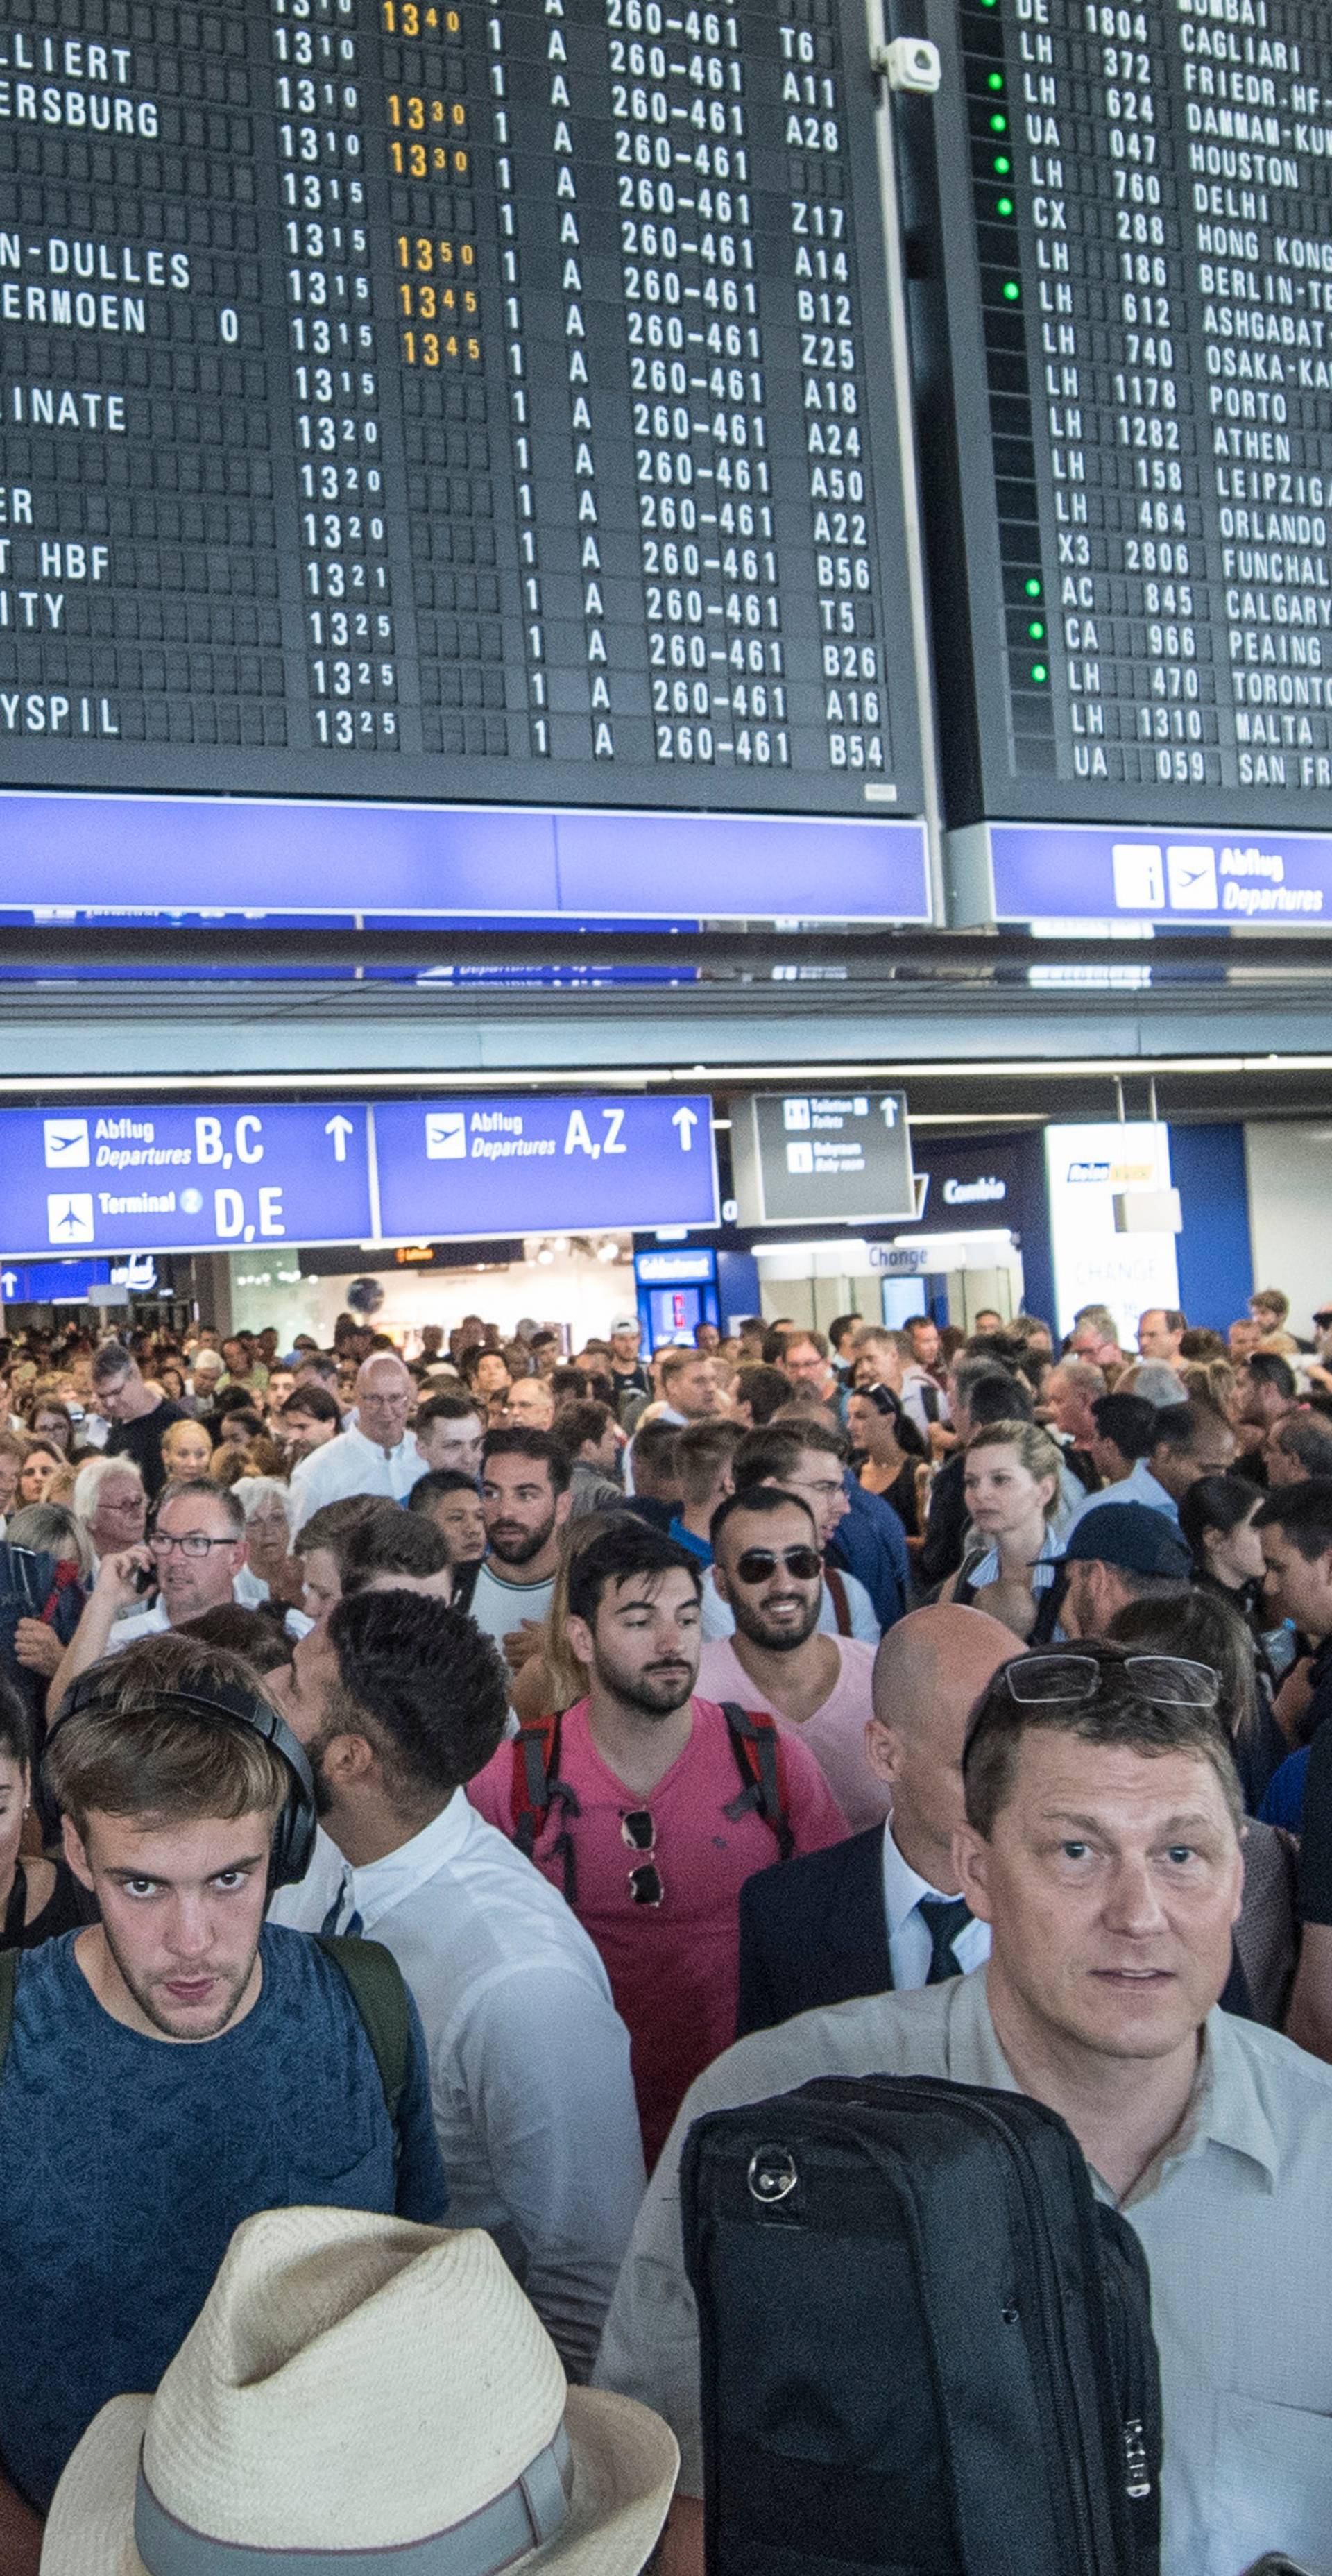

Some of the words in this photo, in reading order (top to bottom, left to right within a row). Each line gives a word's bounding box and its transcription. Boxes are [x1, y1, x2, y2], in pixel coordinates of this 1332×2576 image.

[607, 0, 737, 46] 260-461
[780, 27, 813, 62] T6
[1017, 0, 1048, 22] DE
[1087, 5, 1147, 41] 1804
[1181, 23, 1299, 72] CAGLIARI
[1021, 31, 1052, 63] LH
[1104, 47, 1150, 83] 372
[549, 30, 566, 60] A
[610, 40, 740, 91] 260-461
[783, 71, 832, 108] A11
[0, 33, 130, 83] LIERT
[554, 121, 572, 152] A
[616, 130, 746, 180] 260-461
[613, 85, 742, 135] 260-461
[787, 115, 837, 151] A28
[1025, 73, 1055, 105] LH
[1107, 88, 1153, 122] 624
[1027, 114, 1059, 146] UA
[1111, 129, 1155, 162] 047
[1190, 143, 1298, 187] HOUSTON
[619, 176, 749, 223] 260-461
[792, 202, 843, 237] Z17
[1032, 156, 1062, 187] LH
[1114, 170, 1160, 204] 760
[1194, 183, 1267, 221] DELHI
[561, 212, 579, 244] A
[622, 221, 752, 268] 260-461
[796, 246, 848, 281] A14
[1034, 197, 1066, 229] CX
[1118, 211, 1163, 244] 288
[1198, 223, 1258, 260] HONG
[1276, 237, 1332, 272] KONG
[1038, 239, 1068, 271] LH
[1123, 253, 1166, 286] 186
[0, 232, 189, 288] N-DULLES
[567, 305, 584, 336] A
[628, 312, 758, 357] 260-461
[802, 334, 854, 369] Z25
[624, 266, 755, 312] 260-461
[799, 290, 851, 325] B12
[1040, 281, 1072, 312] LH
[1124, 293, 1170, 327] 612
[3, 283, 144, 332] ERMOEN
[631, 357, 760, 402] 260-461
[805, 378, 856, 413] A18
[1043, 323, 1075, 354] LH
[1127, 334, 1172, 368] 740
[1206, 345, 1332, 388] OSAKA-KA
[1047, 365, 1078, 396] LH
[1116, 374, 1176, 409] 1178
[1210, 385, 1286, 423] PORTO
[14, 387, 125, 430] INATE
[637, 449, 768, 491] 260-461
[812, 467, 863, 501] A50
[573, 397, 591, 429] A
[634, 403, 764, 446] 260-461
[809, 423, 860, 457] A24
[1050, 407, 1081, 438] LH
[1120, 415, 1179, 450] 1282
[1214, 427, 1290, 462] ATHEN
[1052, 448, 1084, 480] LH
[1138, 458, 1181, 491] 158
[1217, 467, 1332, 507] LEIPZIG
[579, 489, 597, 521] A
[640, 495, 771, 536] 260-461
[814, 511, 866, 545] A22
[1056, 491, 1087, 523] LH
[1139, 500, 1186, 532] 464
[1220, 507, 1326, 547] ORLANDO
[41, 542, 108, 579] HBF
[585, 582, 604, 614] A
[647, 586, 778, 627] 260-461
[820, 599, 854, 632] T5
[643, 541, 775, 582] 260-461
[818, 555, 869, 589] B56
[1059, 533, 1090, 565] X3
[1126, 539, 1188, 573] 2806
[1222, 547, 1329, 586] FUNCHAL
[1061, 575, 1093, 607] AC
[1145, 581, 1193, 616] 845
[1226, 588, 1331, 626] CALGARY
[0, 591, 63, 628] ITY
[650, 633, 780, 672] 260-461
[823, 644, 876, 678] B26
[1066, 620, 1098, 649] CA
[1148, 622, 1195, 656] 966
[592, 676, 610, 708] A
[654, 678, 784, 718] 260-461
[826, 689, 879, 722] A16
[1068, 661, 1100, 693] LH
[1152, 663, 1198, 698] 470
[0, 693, 118, 733] YSPIL
[658, 725, 789, 763] 260-461
[830, 732, 882, 767] B54
[1072, 702, 1103, 734] LH
[1141, 707, 1202, 739] 1310
[1236, 712, 1312, 745] MALTA
[1075, 745, 1107, 776] UA
[1159, 749, 1204, 780] 059
[1240, 753, 1285, 784] SAN
[1302, 756, 1330, 786] FR
[1220, 848, 1283, 882] Abflug
[1222, 881, 1323, 915] Departures
[95, 1119, 154, 1143] Abflug
[195, 1115, 264, 1169] B,C
[470, 1112, 522, 1135] Abflug
[471, 1137, 556, 1161] Departures
[564, 1108, 626, 1160] A,Z
[96, 1145, 191, 1170] Departures
[98, 1191, 176, 1214] Terminal
[214, 1187, 286, 1242] D,E
[869, 1248, 928, 1271] Change
